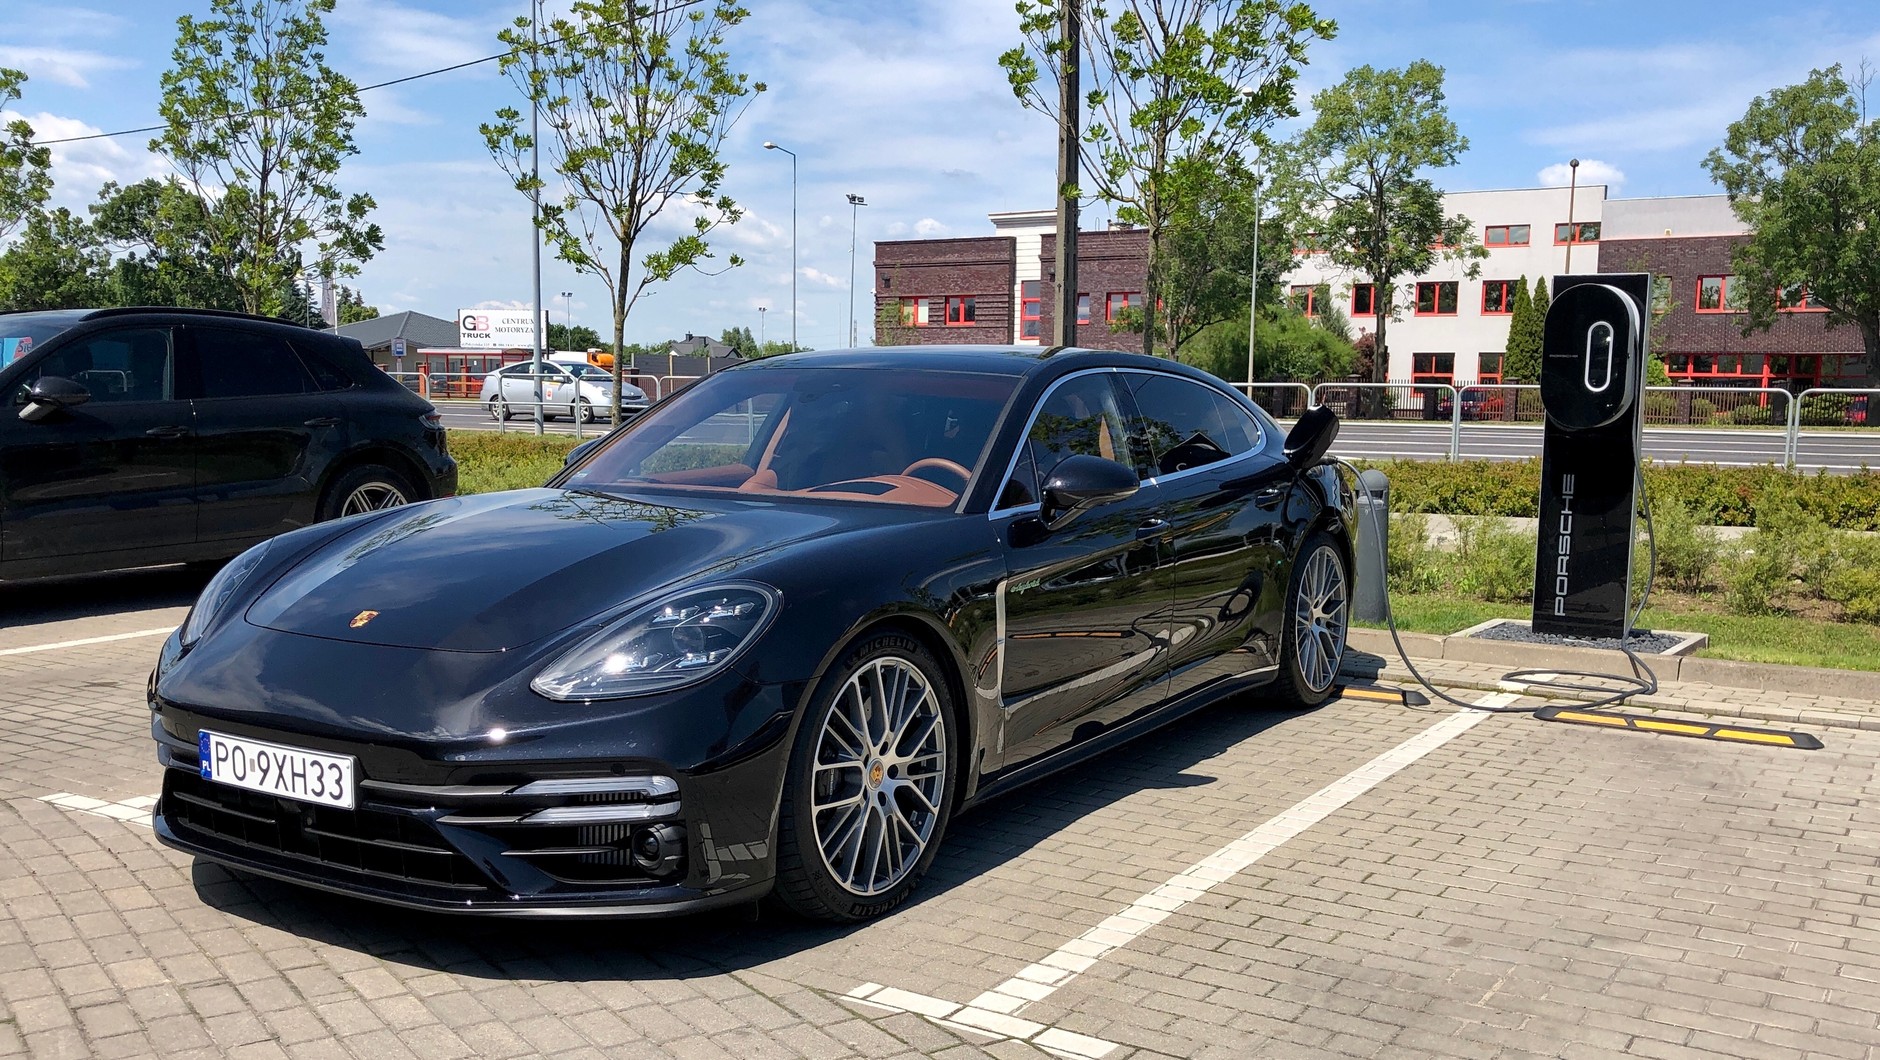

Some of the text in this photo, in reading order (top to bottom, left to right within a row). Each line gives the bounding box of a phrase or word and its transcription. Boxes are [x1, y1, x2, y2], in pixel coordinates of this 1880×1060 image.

[462, 315, 490, 331] GB
[1555, 473, 1576, 617] PORSCHE
[859, 636, 916, 657] MICHELIN
[202, 760, 212, 772] PL
[215, 741, 344, 801] PO 9XH33
